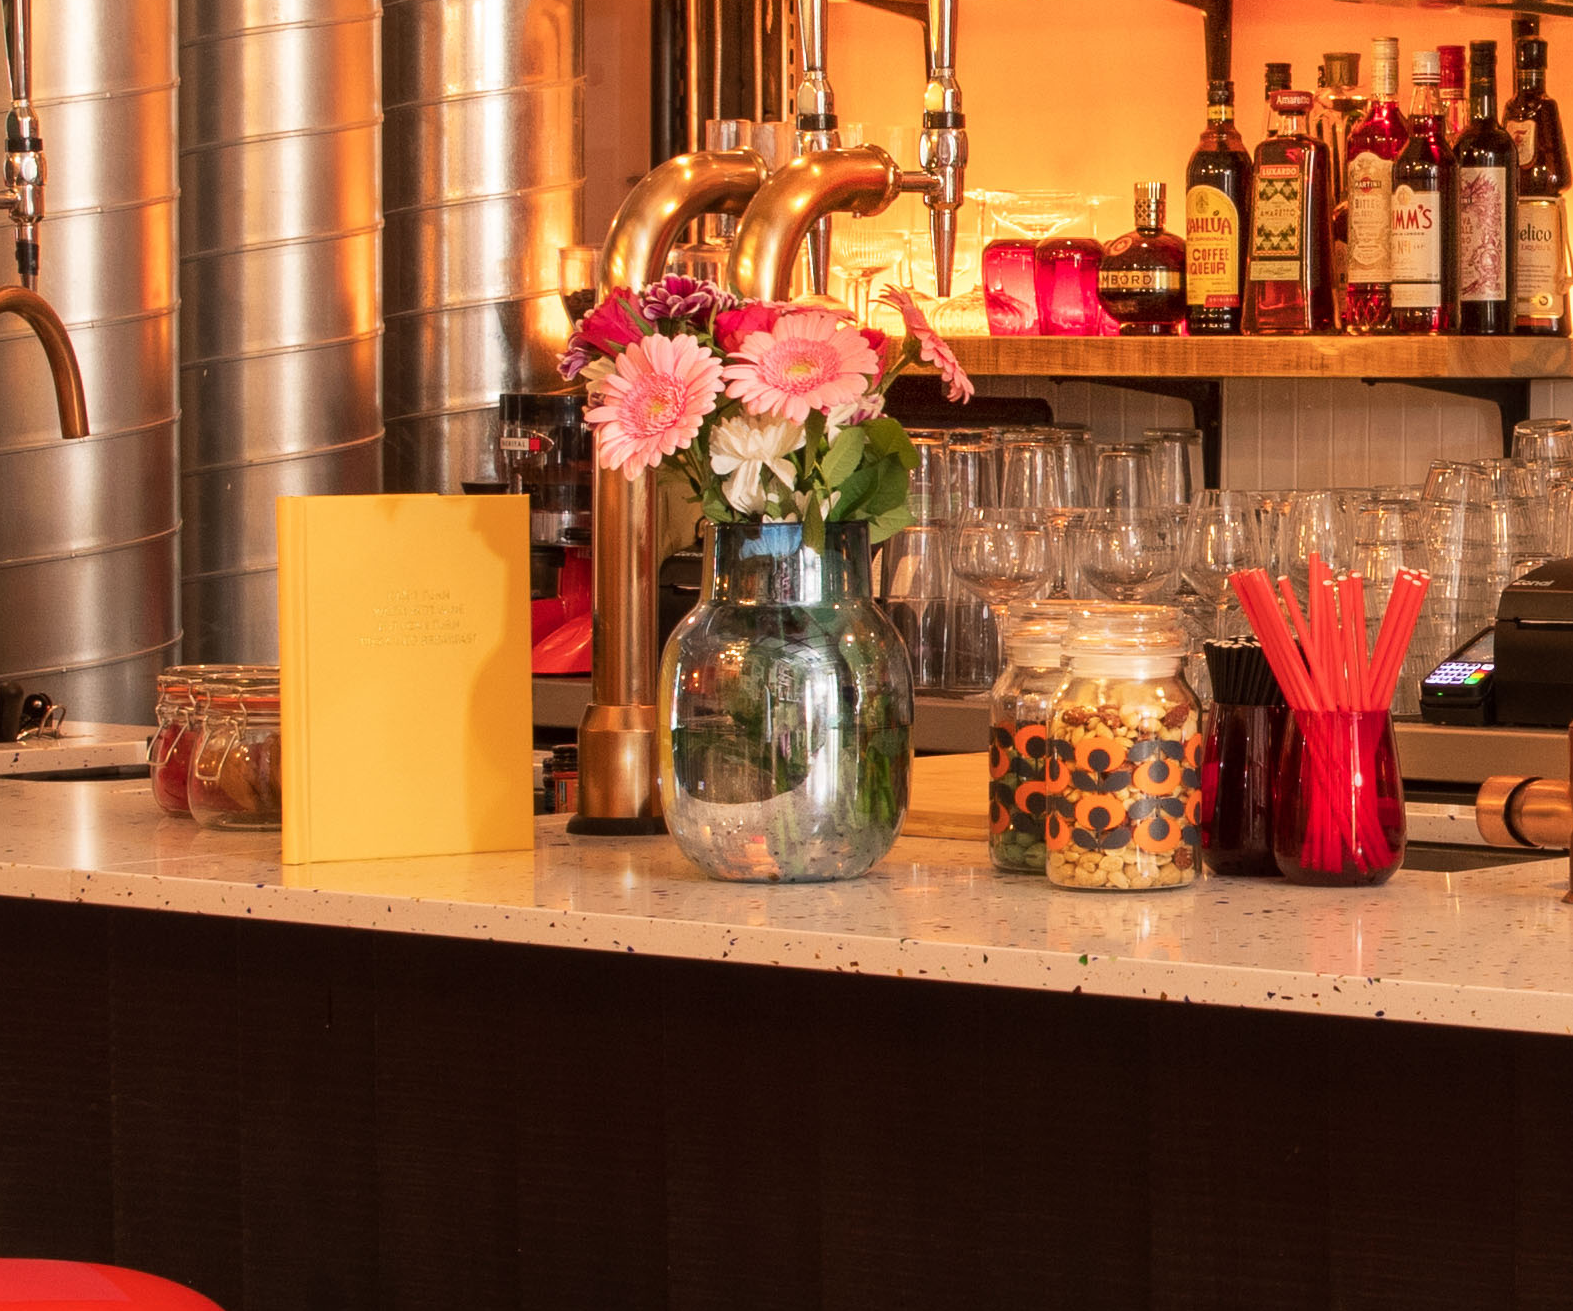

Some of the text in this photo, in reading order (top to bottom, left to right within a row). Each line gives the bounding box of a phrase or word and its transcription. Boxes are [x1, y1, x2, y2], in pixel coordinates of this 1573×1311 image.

[1277, 95, 1311, 105] Amaretto
[1262, 167, 1297, 177] LUXARDO
[1260, 208, 1295, 218] AMARETTO
[1192, 249, 1229, 261] COFFEE
